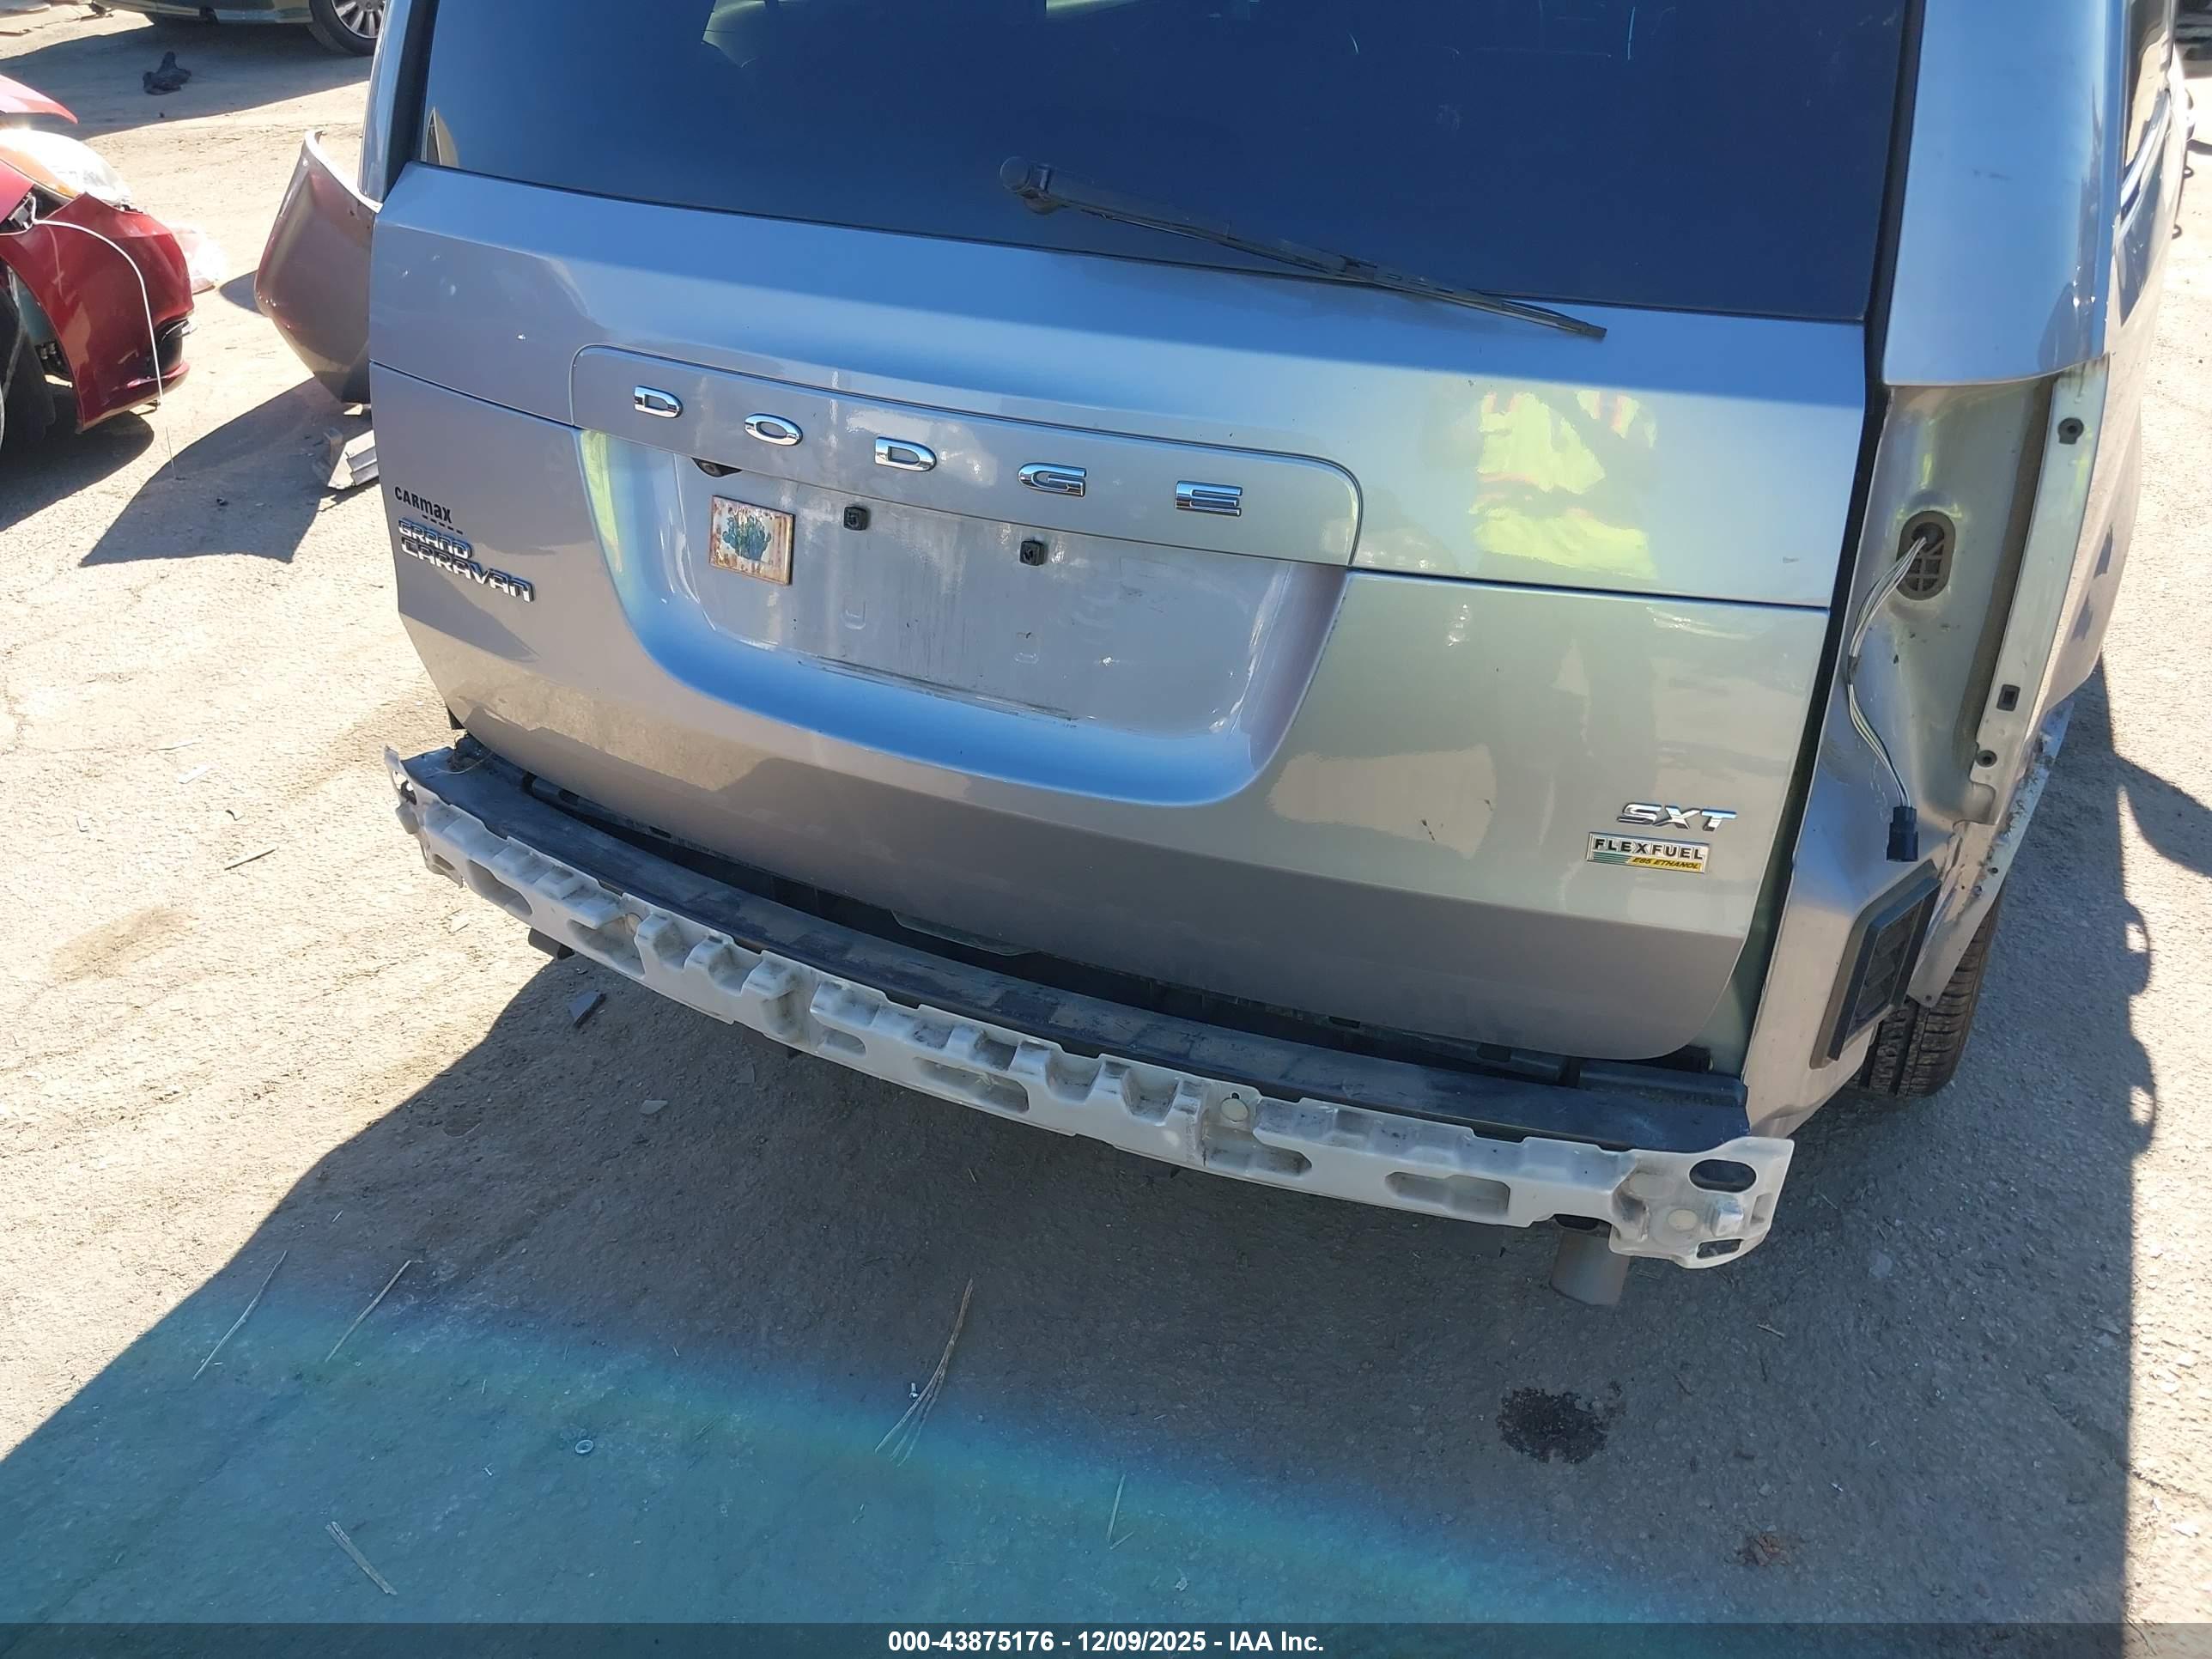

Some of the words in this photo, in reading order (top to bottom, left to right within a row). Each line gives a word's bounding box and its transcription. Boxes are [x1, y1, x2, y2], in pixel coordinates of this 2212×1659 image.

[634, 384, 1243, 517] DODGE
[394, 486, 452, 524] CARmax
[398, 517, 473, 559] GRAND
[401, 537, 534, 602] CARAVAN
[1617, 802, 1737, 831] SXT
[1595, 838, 1705, 860] FLEXFUEL
[1654, 860, 1699, 869] ETHANOL
